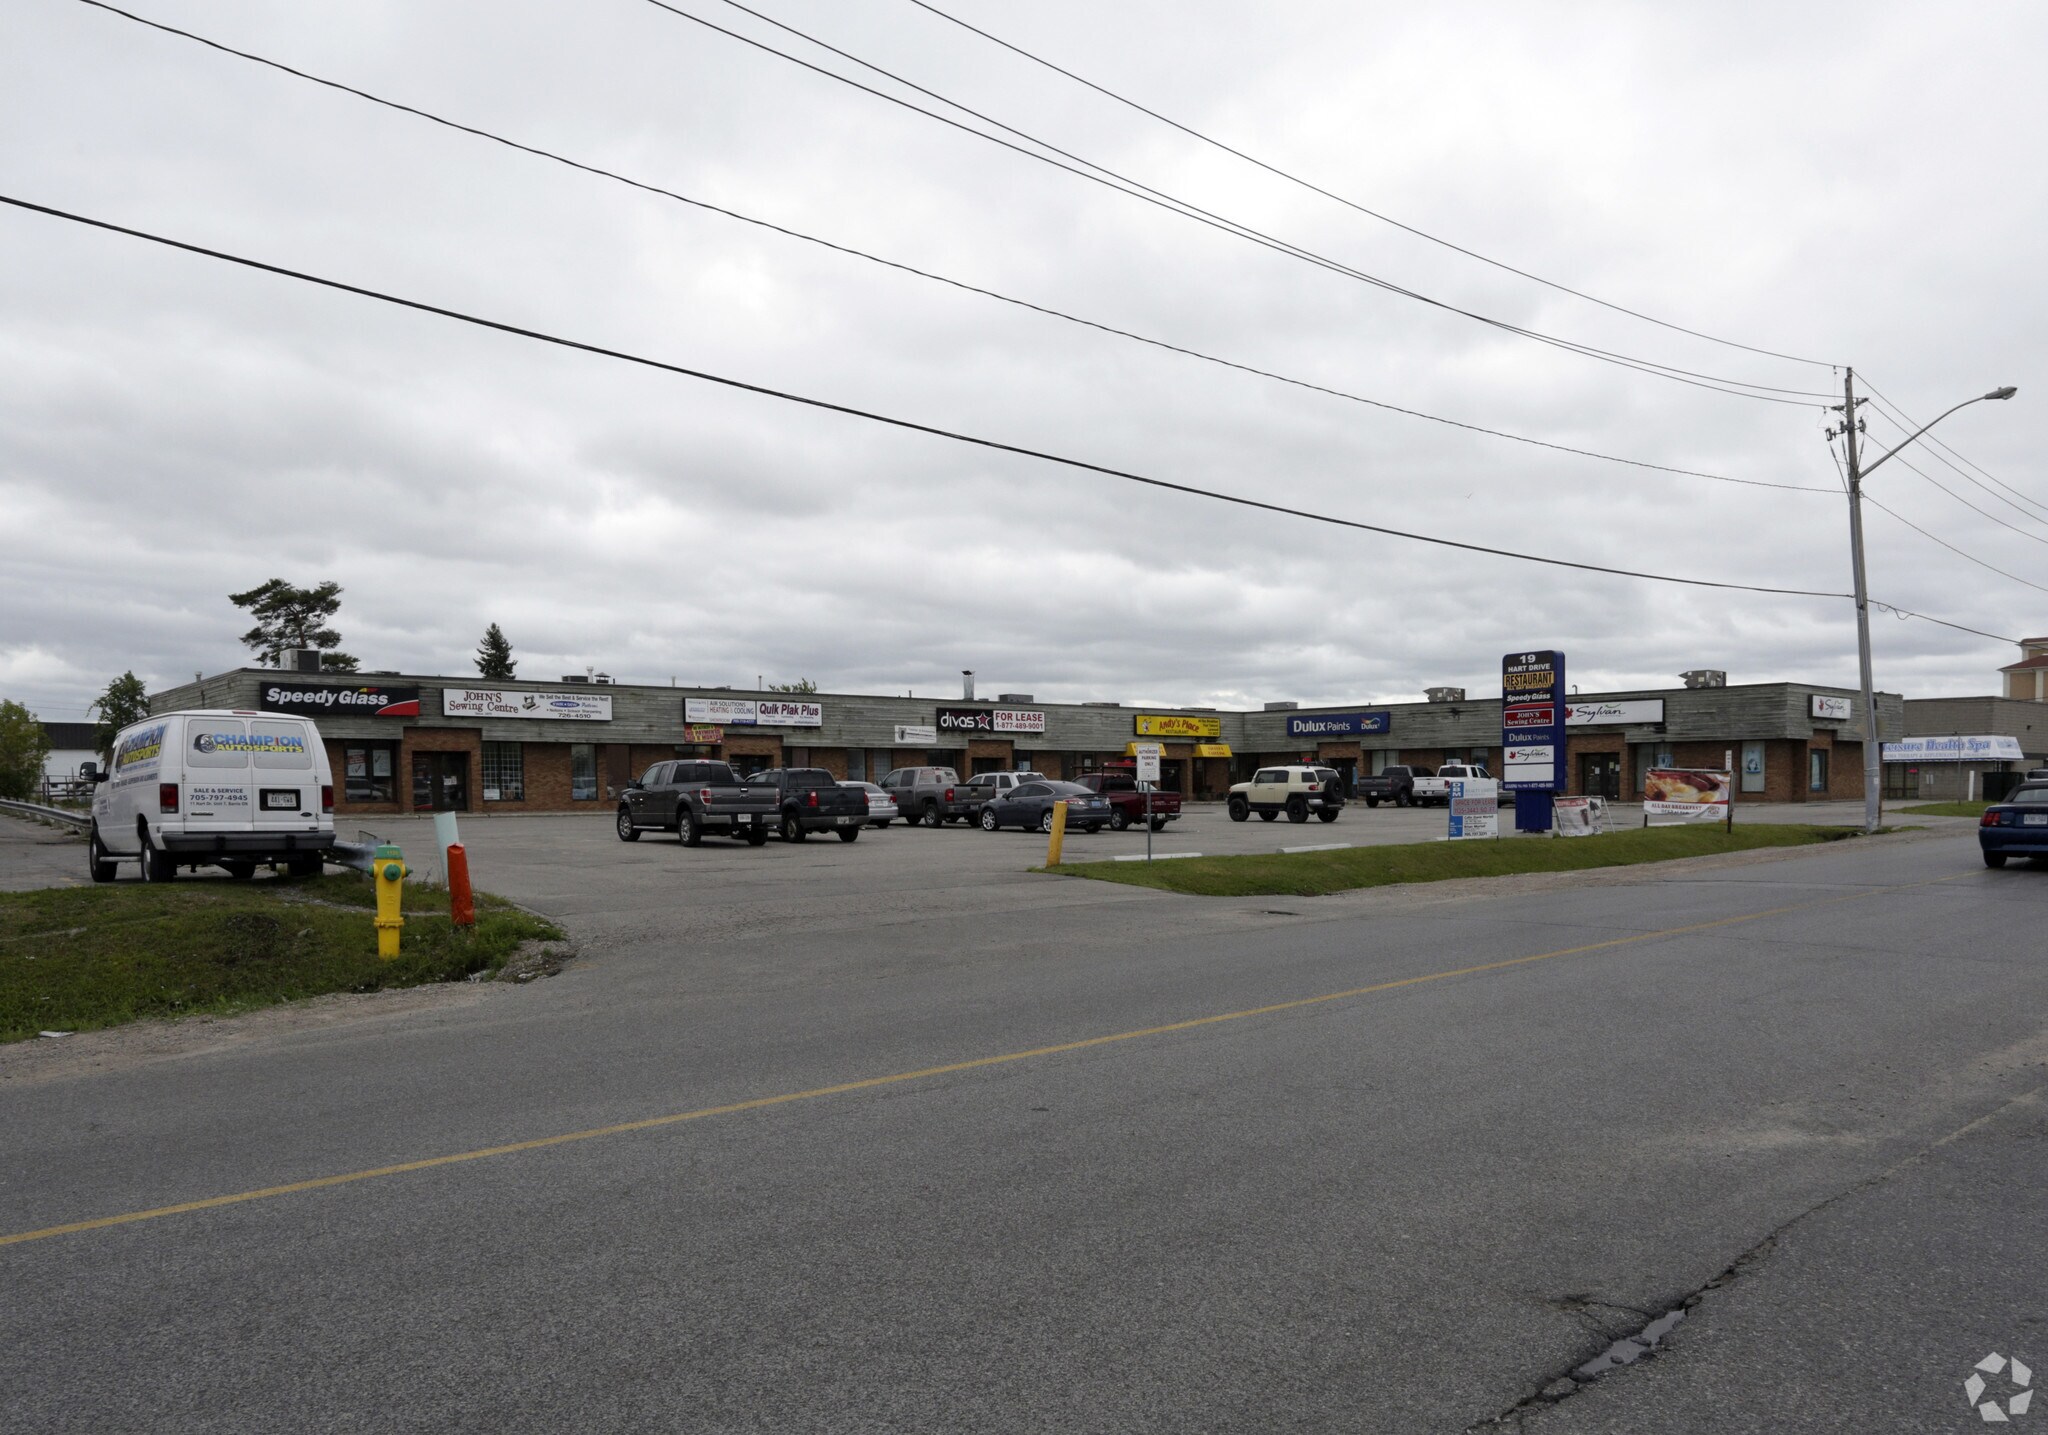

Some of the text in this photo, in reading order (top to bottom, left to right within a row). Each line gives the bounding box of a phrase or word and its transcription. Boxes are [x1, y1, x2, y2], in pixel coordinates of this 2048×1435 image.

[1520, 654, 1536, 663] 19
[1528, 663, 1551, 671] DRIVE
[1506, 672, 1552, 686] RESTAURANT
[266, 688, 389, 706] Speedy Glass
[464, 691, 502, 703] JOHN'S
[1507, 694, 1532, 702] Speedy
[449, 701, 519, 713] Sewing Centre
[734, 707, 754, 715] COOLING
[759, 703, 819, 716] Quik Plak Plus
[995, 712, 1043, 722] FOR LEASE
[1576, 705, 1626, 722] Sylvan
[940, 712, 975, 728] divas
[996, 722, 1043, 730] 1-877-489-9001
[1159, 718, 1200, 733] Andy's Place
[1293, 720, 1350, 733] Dulux Paints
[213, 734, 303, 746] CHAMPION
[1509, 733, 1532, 742] Dulux
[216, 744, 303, 753] AUTOSPORTS
[1926, 738, 1965, 751] Health
[1967, 738, 1991, 752] Spa
